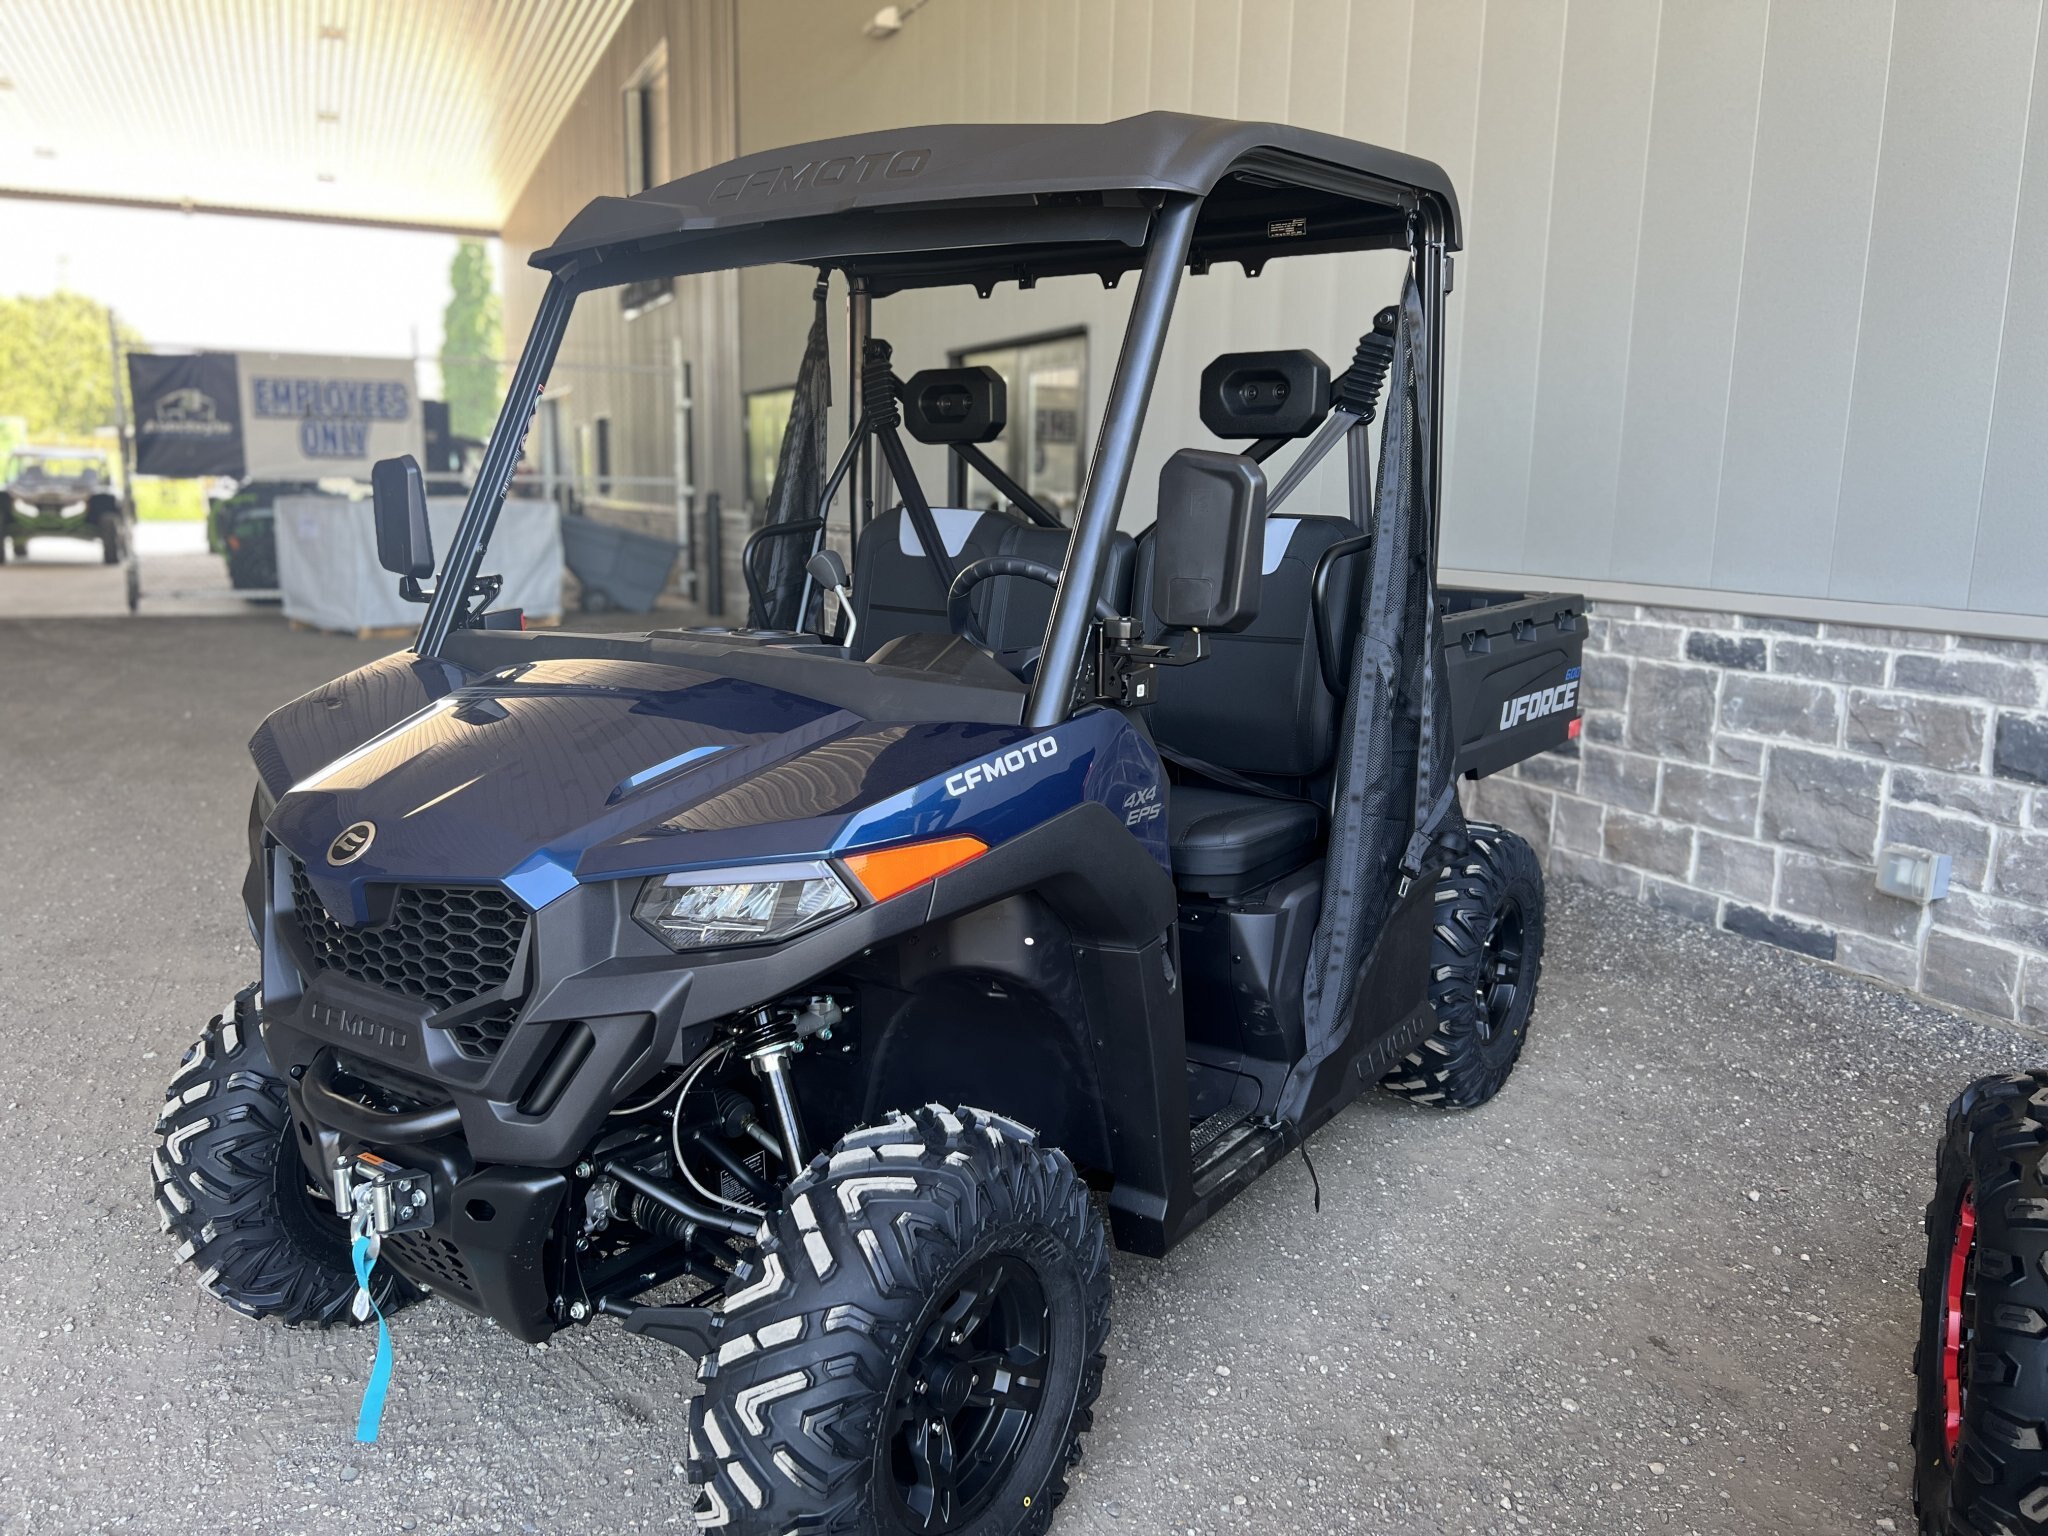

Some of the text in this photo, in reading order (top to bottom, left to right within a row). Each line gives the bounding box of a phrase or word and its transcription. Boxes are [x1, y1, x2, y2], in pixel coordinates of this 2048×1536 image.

[708, 148, 932, 202] CFMOTO
[252, 377, 411, 421] EMPLOYEES
[300, 420, 370, 459] ONLY
[1500, 681, 1579, 731] UFORCE
[945, 736, 1058, 797] CFMOTO
[1123, 784, 1158, 810] 4X4
[1126, 803, 1161, 827] EPS
[310, 1001, 409, 1051] CFMOTO
